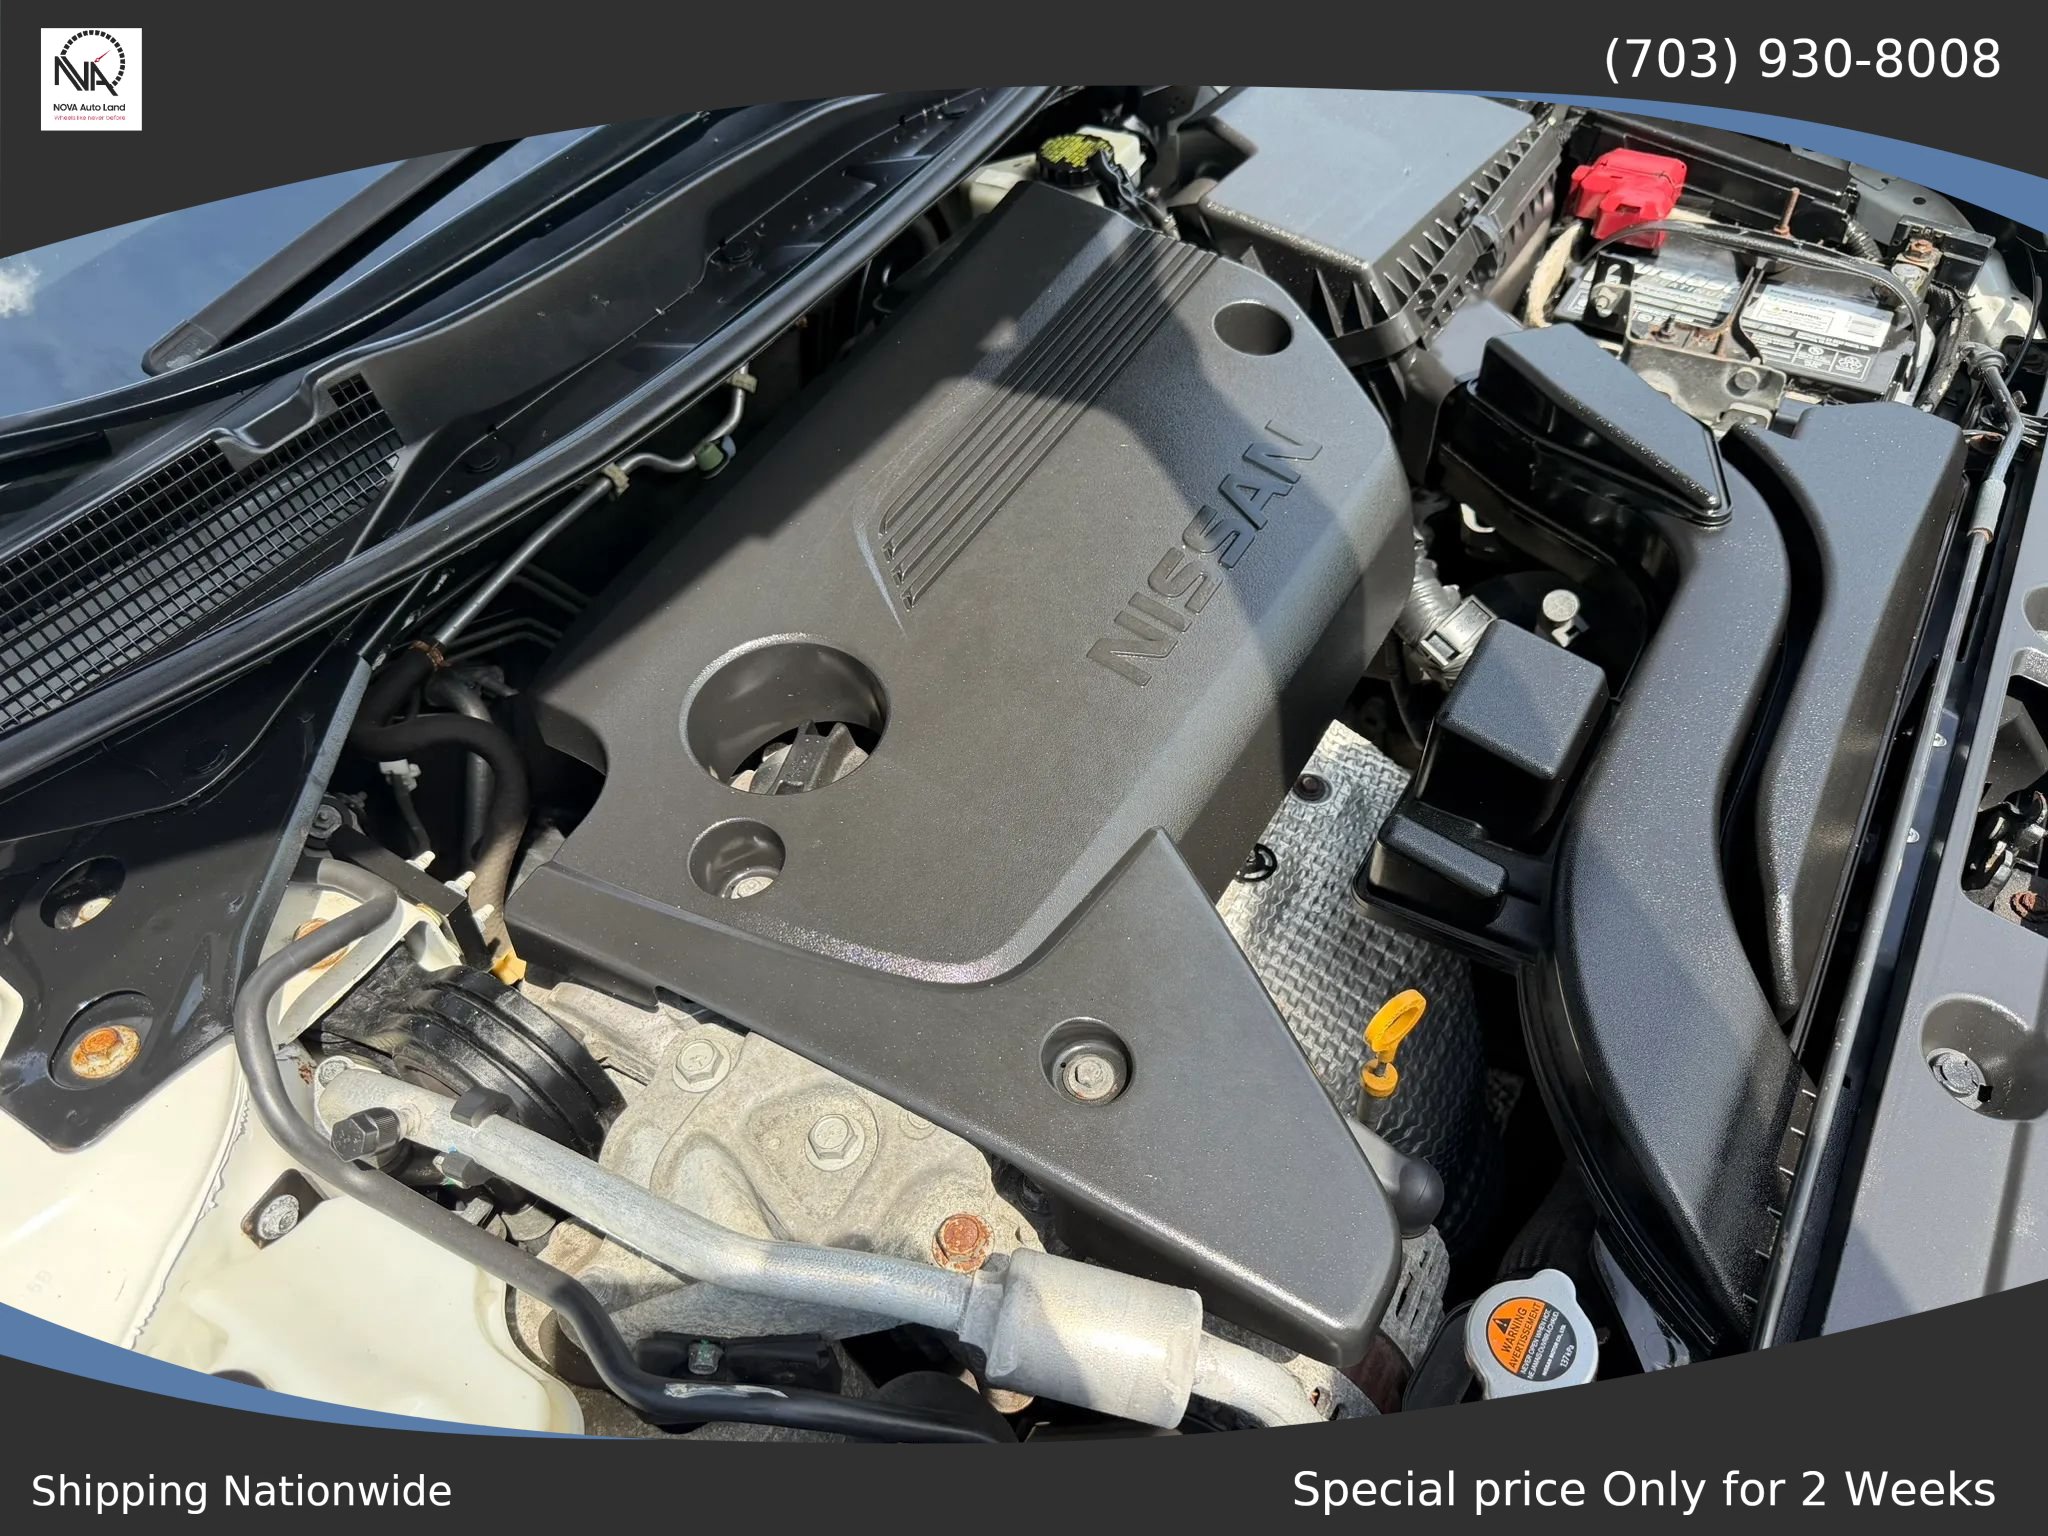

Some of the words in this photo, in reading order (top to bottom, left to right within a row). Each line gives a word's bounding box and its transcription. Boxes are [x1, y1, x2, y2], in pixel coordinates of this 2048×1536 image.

[1086, 419, 1323, 687] NISSAN
[1501, 1307, 1528, 1353] WARNING
[1508, 1302, 1541, 1369] AVERTISSEMENT
[1520, 1354, 1532, 1375] NEVER
[1528, 1338, 1539, 1355] OPEN
[1534, 1320, 1546, 1339] WHEN
[1564, 1343, 1575, 1357] kPa
[1542, 1358, 1552, 1377] NISSAN
[1549, 1341, 1559, 1359] MOTOR
[1559, 1354, 1570, 1368] 137
